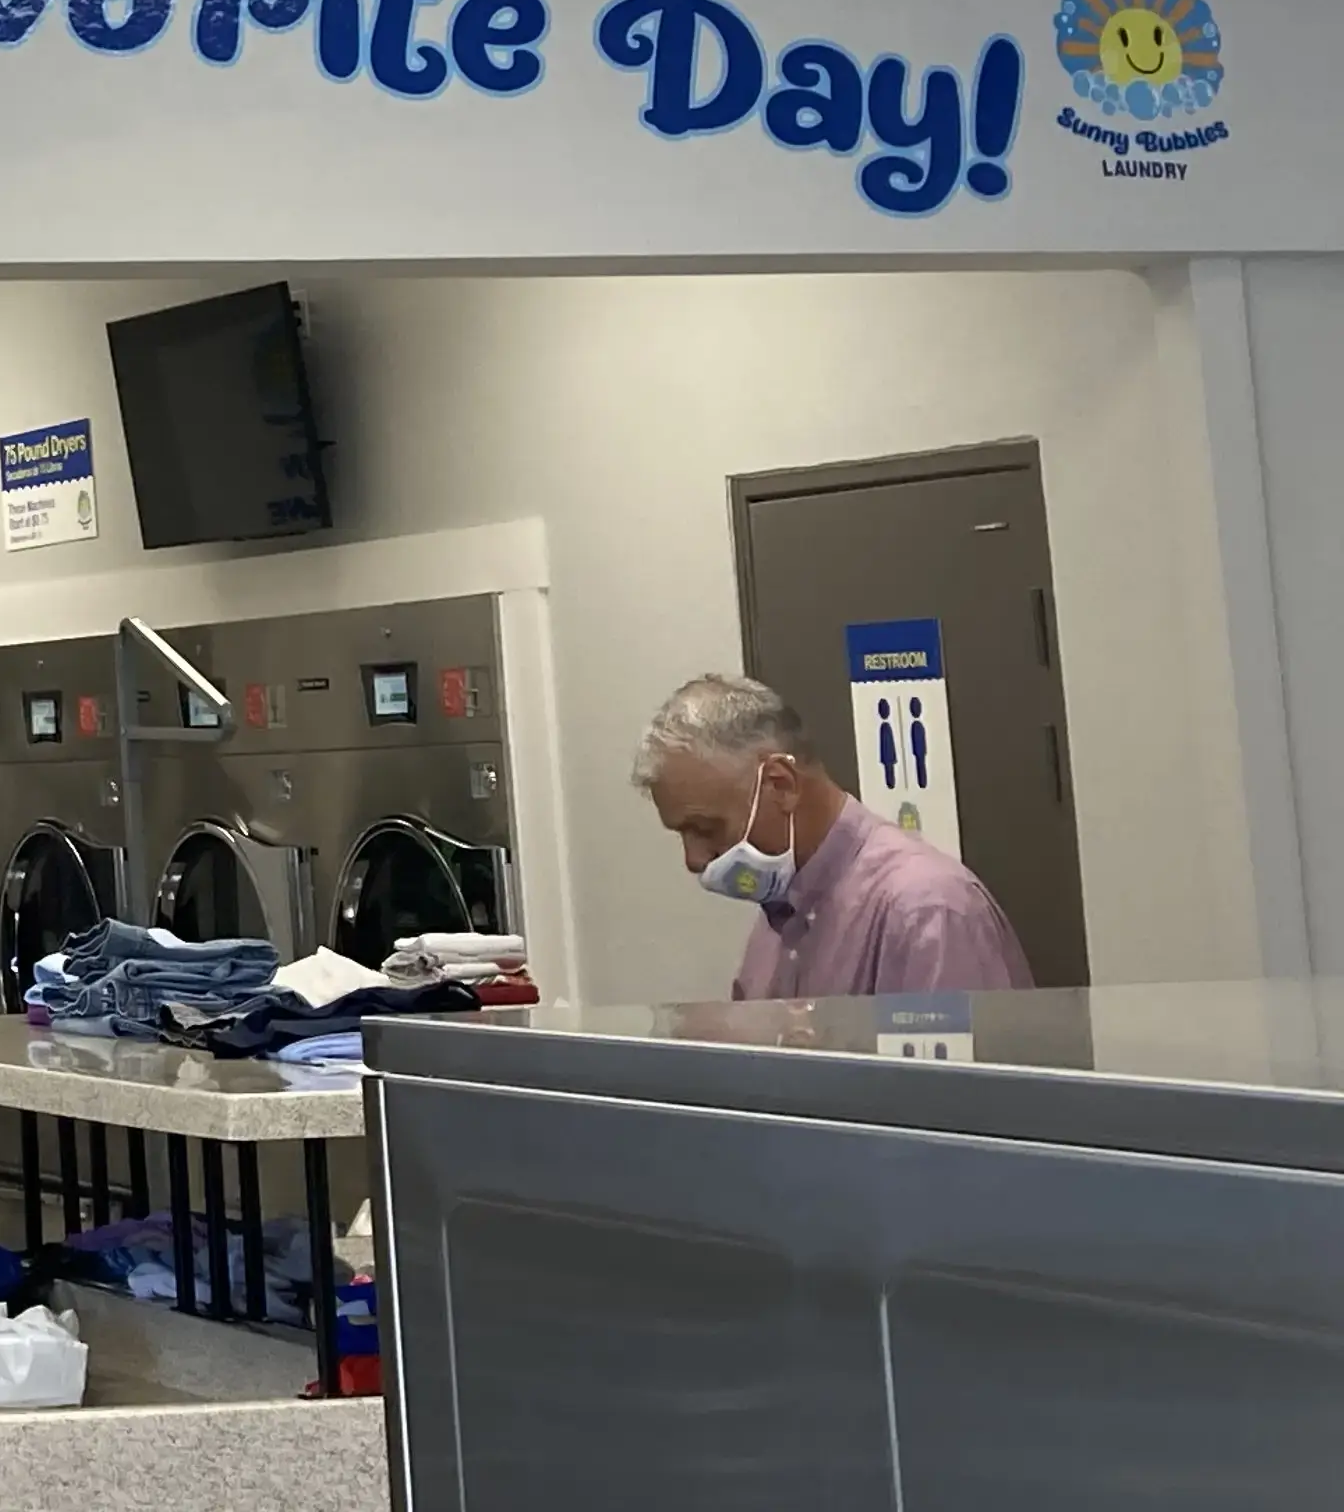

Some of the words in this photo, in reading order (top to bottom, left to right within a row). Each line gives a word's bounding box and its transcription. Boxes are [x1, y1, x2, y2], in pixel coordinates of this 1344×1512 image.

[1056, 106, 1130, 155] Sunny
[1135, 120, 1229, 153] Bubbles
[1101, 159, 1188, 181] LAUNDRY
[18, 436, 50, 464] Pound
[51, 433, 87, 460] Dryers
[863, 651, 928, 671] RESTROOM
